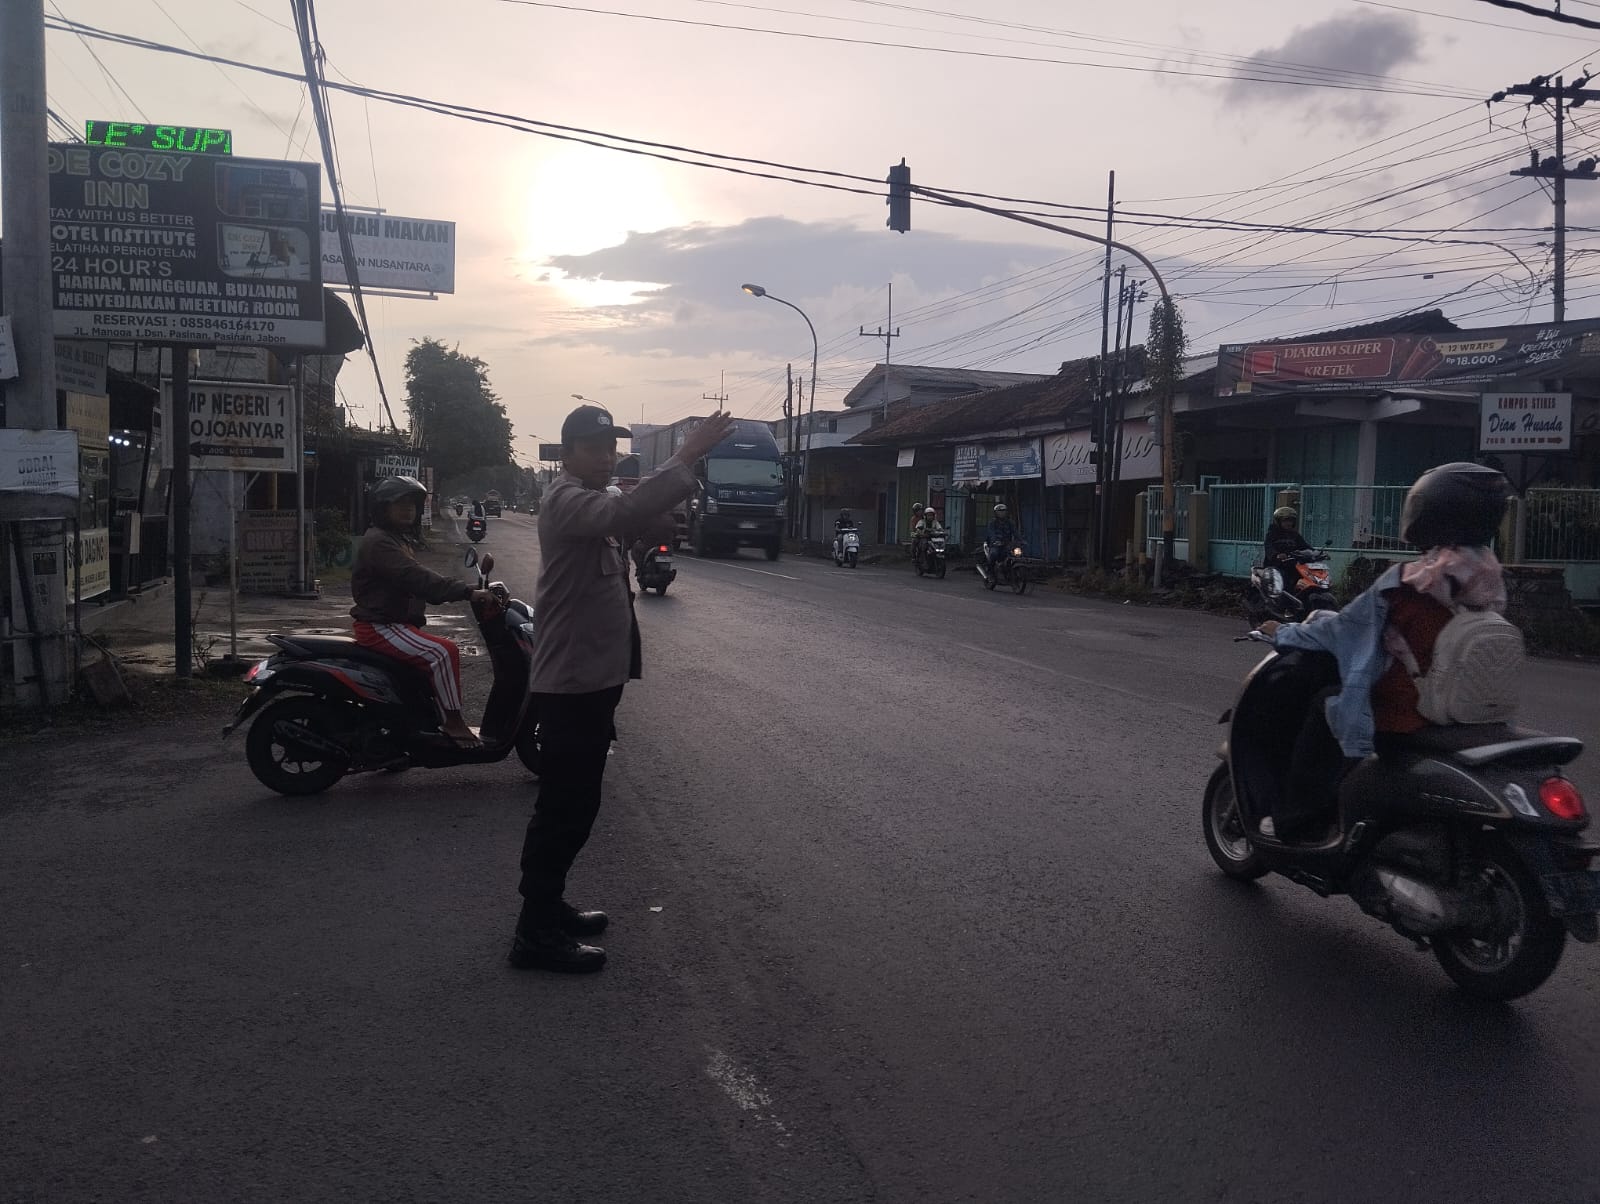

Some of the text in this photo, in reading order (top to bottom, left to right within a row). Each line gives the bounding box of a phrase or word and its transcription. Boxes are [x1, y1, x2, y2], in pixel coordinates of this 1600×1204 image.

[48, 149, 191, 182] DE COZY
[84, 180, 149, 209] INN
[77, 209, 113, 221] WITH
[117, 211, 136, 222] US
[139, 213, 194, 226] BETTER
[384, 219, 449, 243] MAKAN
[112, 245, 196, 259] PERHOTELAN
[52, 256, 172, 277] 24 HOUR'S
[368, 258, 432, 273] NUSANTARA
[58, 276, 297, 300] HARIAN, MINGGUAN, BULANAN
[58, 292, 300, 317] MENYEDIAKAN MEETING ROOM
[93, 314, 168, 327] RESERVASI
[179, 317, 275, 332] 085846164170
[73, 326, 89, 336] JL.
[257, 333, 286, 344] Jabon
[1338, 342, 1382, 355] SUPER
[1448, 341, 1495, 353] 12 WRAPS
[1304, 364, 1355, 377] KRETEK
[1446, 357, 1455, 366] Rp
[211, 393, 270, 417] NEGERI
[276, 396, 284, 417] 1
[190, 419, 285, 440] OJOANYAR
[1488, 412, 1563, 433] Dian Husada
[376, 466, 417, 478] JAKARTA
